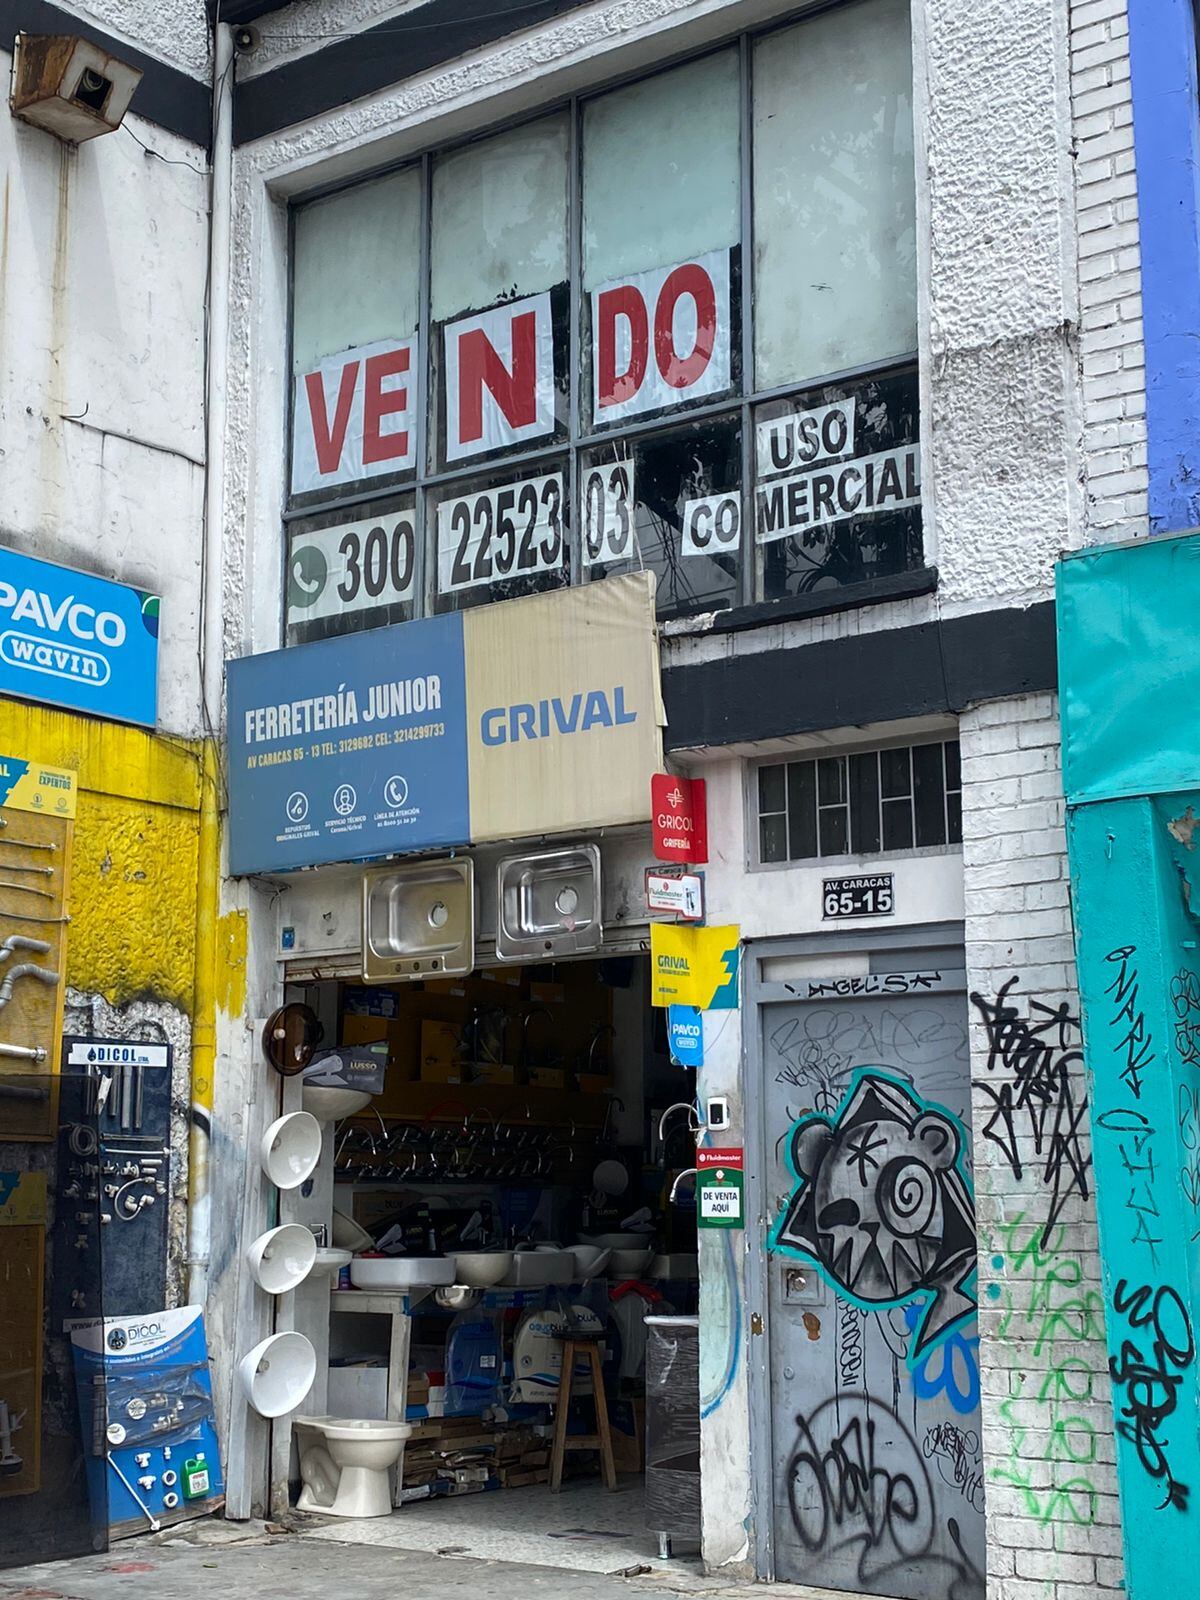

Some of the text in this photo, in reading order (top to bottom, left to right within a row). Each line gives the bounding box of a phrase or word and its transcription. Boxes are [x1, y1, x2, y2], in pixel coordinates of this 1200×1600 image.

[769, 410, 848, 469] USO
[337, 467, 631, 602] 300 22523 03
[0, 581, 126, 647] PAVCO
[11, 639, 98, 678] wavin
[245, 675, 441, 744] FERRETERÍA JUNIOR
[480, 686, 637, 746] GRIVAL
[247, 755, 257, 769] AV
[258, 749, 292, 767] CARACAS
[311, 744, 320, 758] 13
[322, 742, 337, 756] TEL:
[375, 732, 392, 746] CEL:
[657, 813, 694, 832] GRICOL
[663, 837, 690, 849] GRIFERÍA
[825, 877, 890, 891] AV. CARACAS
[825, 889, 891, 915] 65-15
[657, 955, 690, 970] GRIVAL
[672, 1023, 700, 1036] PAVCO
[98, 1048, 136, 1062] DICOL
[350, 1062, 377, 1071] LUSSO
[703, 1192, 738, 1200] DE VENTA
[127, 1323, 166, 1341] DICOL
